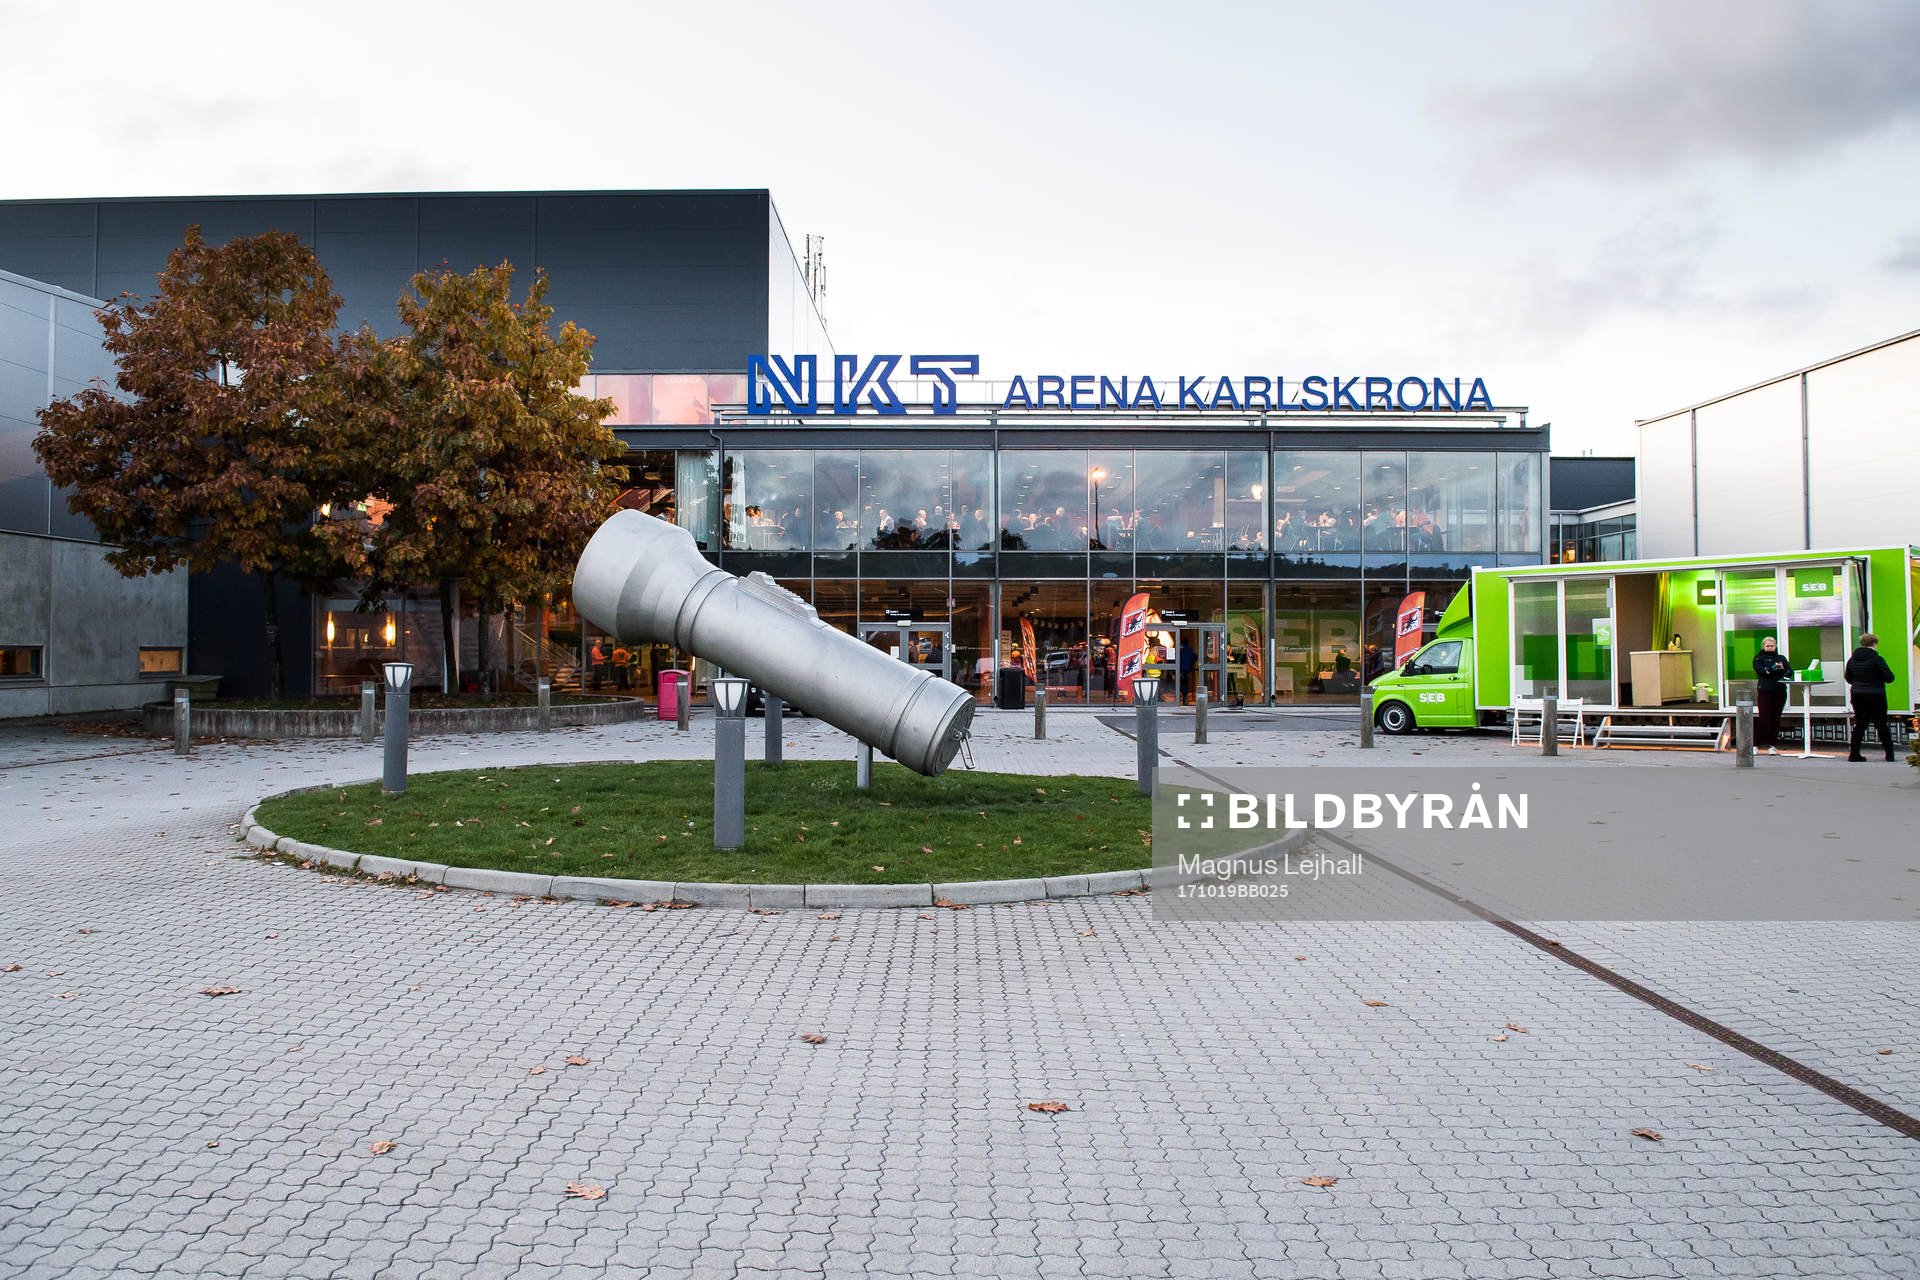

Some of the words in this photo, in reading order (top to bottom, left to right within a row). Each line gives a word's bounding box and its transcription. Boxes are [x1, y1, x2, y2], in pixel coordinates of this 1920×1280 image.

[746, 353, 979, 416] NKT
[1003, 375, 1163, 411] ARENA
[1178, 376, 1495, 412] KARLSKRONA
[1801, 582, 1827, 592] SEB
[1419, 692, 1445, 703] SEB
